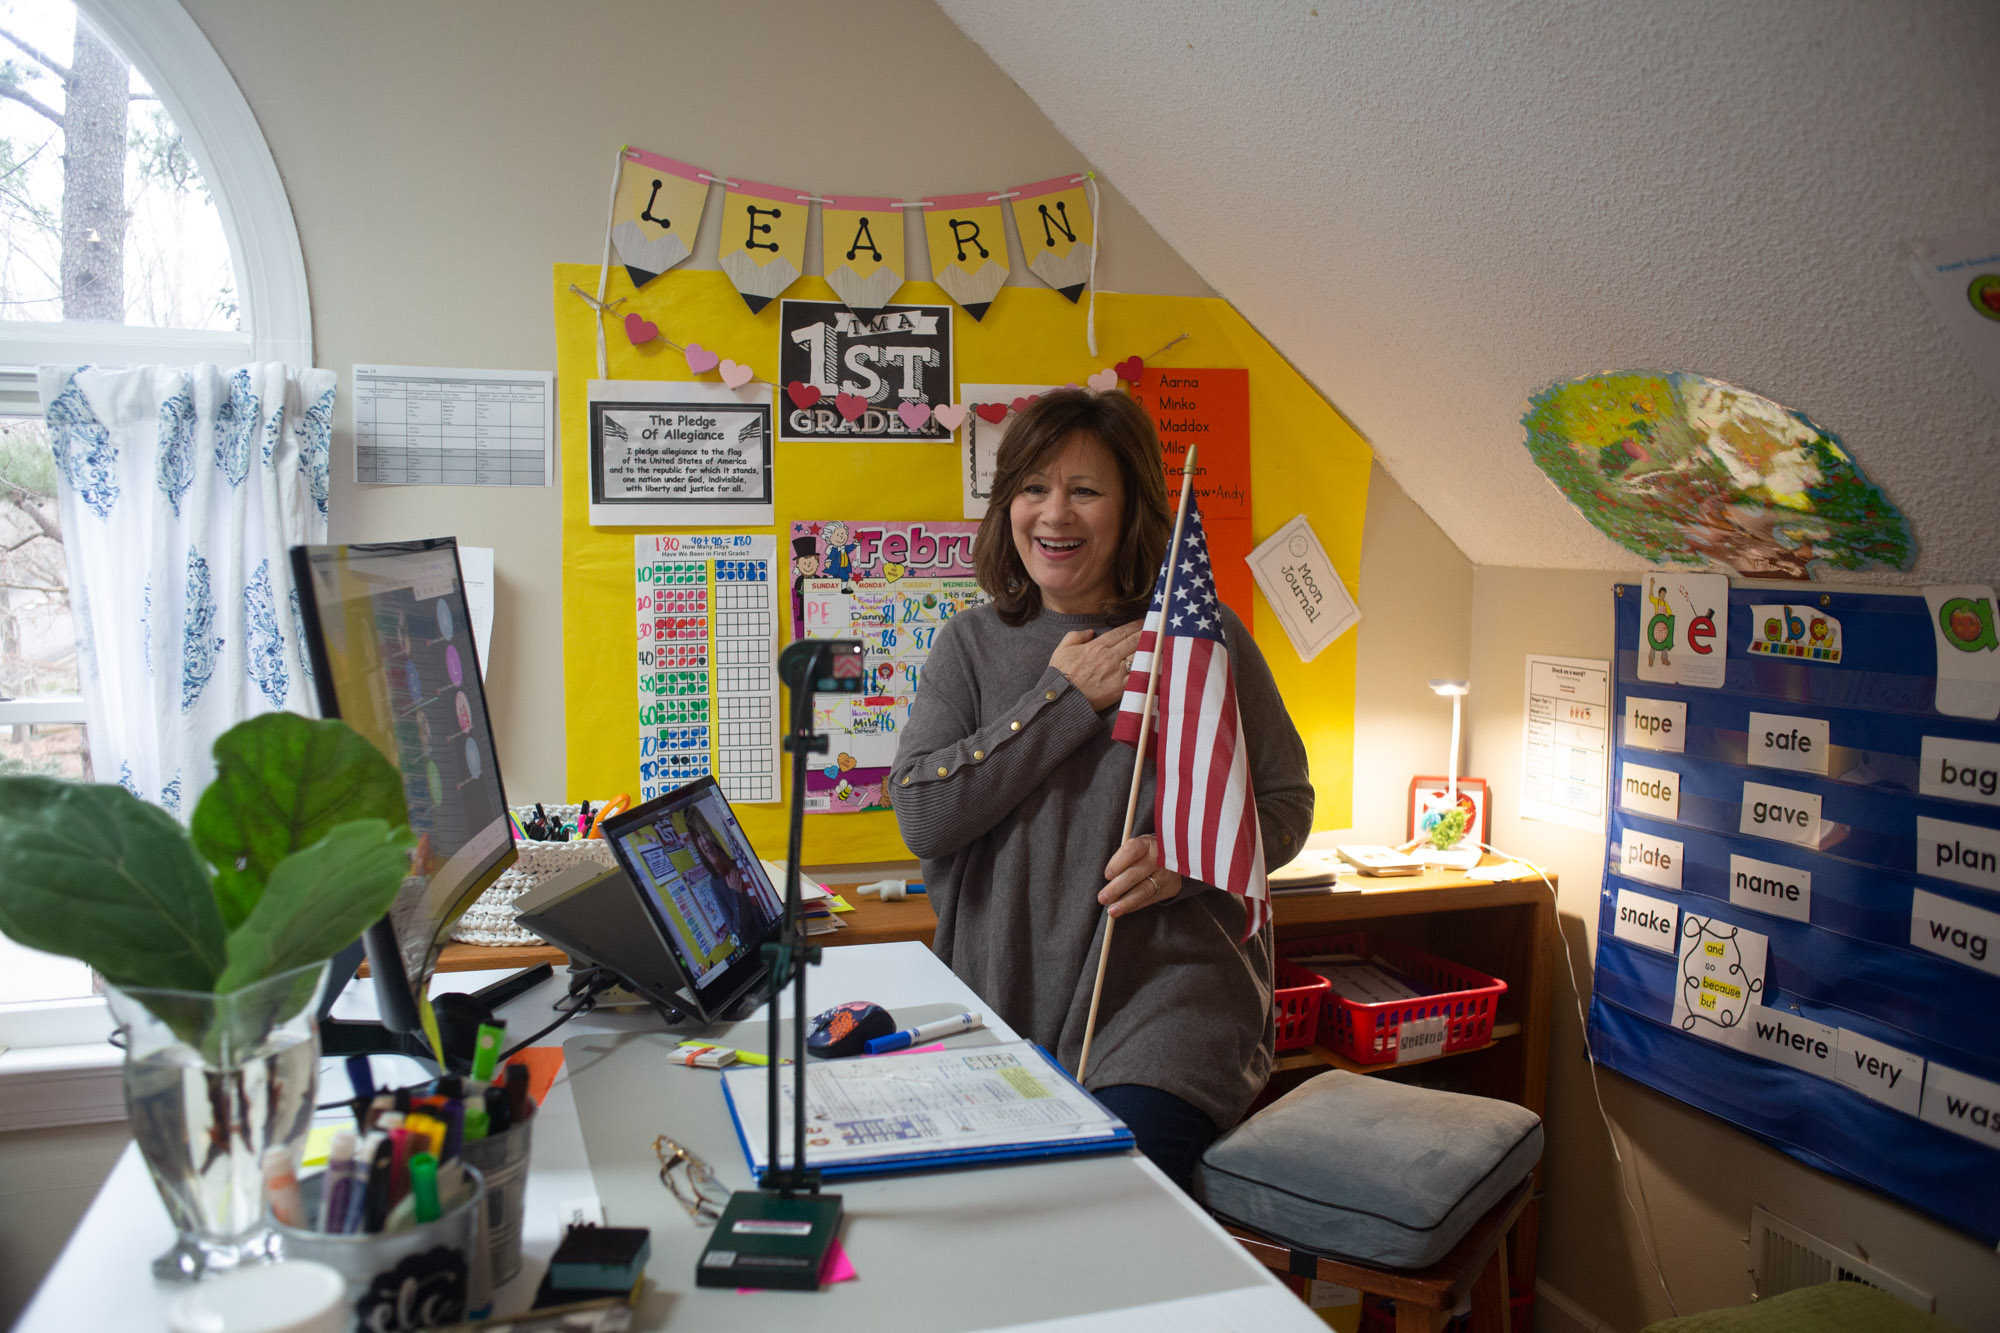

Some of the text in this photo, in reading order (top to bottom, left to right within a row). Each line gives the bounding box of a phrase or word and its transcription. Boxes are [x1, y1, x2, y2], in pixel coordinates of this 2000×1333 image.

[640, 178, 1078, 263] LEARN
[791, 321, 940, 404] 1ST
[1159, 374, 1199, 388] Aarna
[1159, 397, 1196, 410] Minko
[649, 415, 717, 429] The Pledge
[789, 408, 940, 436] GRADE!
[1160, 418, 1209, 432] Maddox
[641, 429, 724, 443] Of Allegiance
[634, 448, 659, 457] pledge
[661, 448, 698, 457] allegiance
[727, 448, 743, 457] flag
[1160, 440, 1186, 454] Mila
[649, 457, 675, 465] United
[677, 457, 703, 465] States
[717, 457, 747, 465] America
[652, 467, 682, 475] republic
[732, 467, 759, 475] stands,
[1162, 462, 1207, 476] Reaan
[645, 485, 671, 494] liberty
[689, 485, 715, 494] justice
[732, 485, 744, 493] all.
[688, 476, 705, 484] God,
[708, 476, 747, 484] indivisible,
[1216, 484, 1245, 507] Andy
[656, 536, 680, 552] 180
[637, 566, 653, 583] 10
[1298, 562, 1323, 604] Moon
[1281, 565, 1321, 624] Journal
[807, 601, 832, 625] PE
[851, 611, 885, 625] Danny
[903, 597, 925, 624] 82
[637, 623, 653, 640] 30
[881, 628, 897, 647] 86
[912, 627, 936, 649] 87
[639, 651, 654, 666] 40
[639, 673, 655, 693] 50
[639, 704, 658, 726] 60
[853, 717, 878, 727] Mila
[876, 712, 896, 732] 96
[1635, 710, 1673, 736] tape
[637, 736, 657, 757] 70
[1765, 729, 1812, 753] safe
[1940, 759, 1998, 796] bag
[1625, 776, 1672, 802] made
[1753, 801, 1809, 828] gave
[1628, 843, 1672, 870] plate
[1936, 842, 1996, 873] plan
[1736, 870, 1800, 901] name
[1620, 904, 1671, 934] snake
[1706, 942, 1725, 956] and
[1929, 920, 1988, 961] wag
[1704, 961, 1716, 971] so
[1702, 976, 1741, 999] because
[1700, 995, 1716, 1009] but
[1755, 1019, 1829, 1060] where
[1854, 1050, 1903, 1088] very
[1946, 1095, 2000, 1133] was
